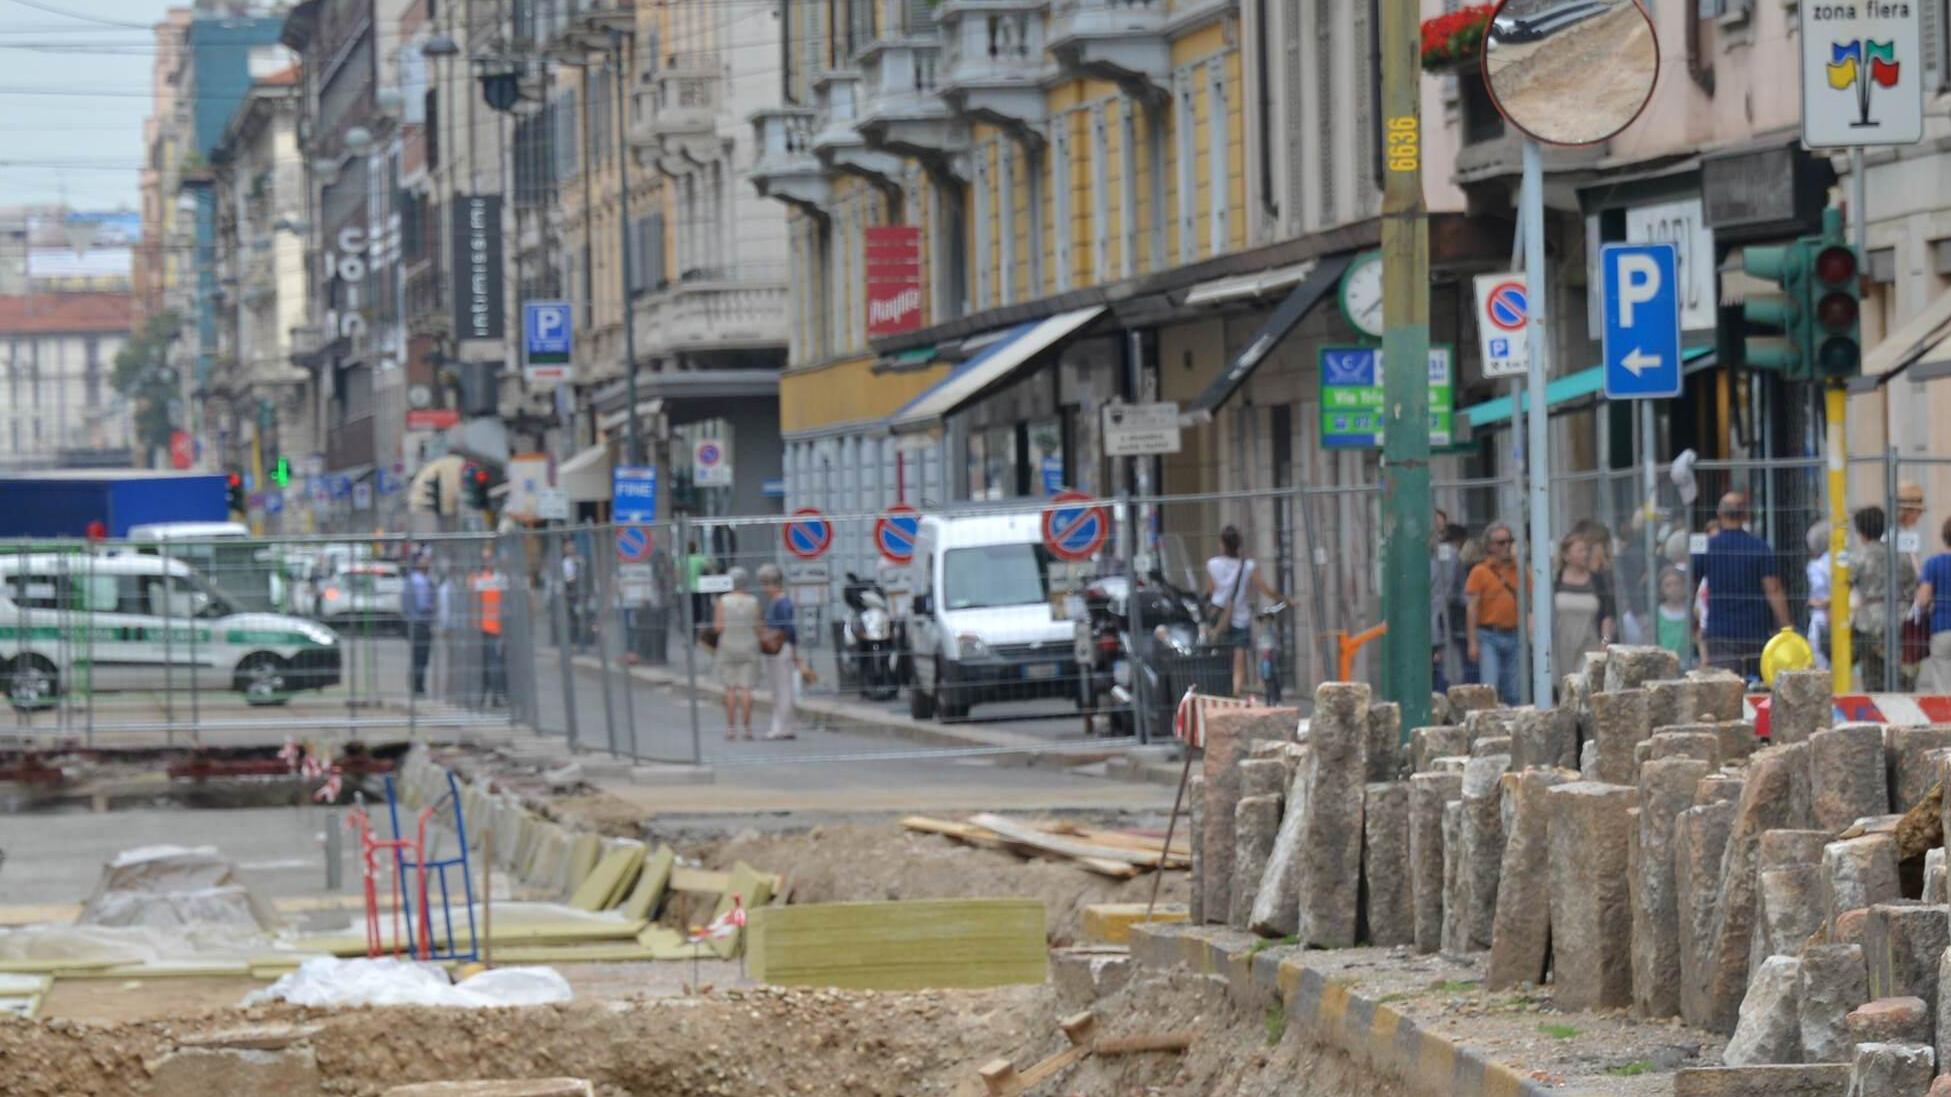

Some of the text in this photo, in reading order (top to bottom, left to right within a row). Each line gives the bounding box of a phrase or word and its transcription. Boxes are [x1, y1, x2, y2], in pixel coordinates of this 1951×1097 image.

[1813, 0, 1910, 20] zona fiera
[1387, 117, 1418, 172] 6636
[1617, 254, 1661, 328] P
[538, 309, 561, 340] P
